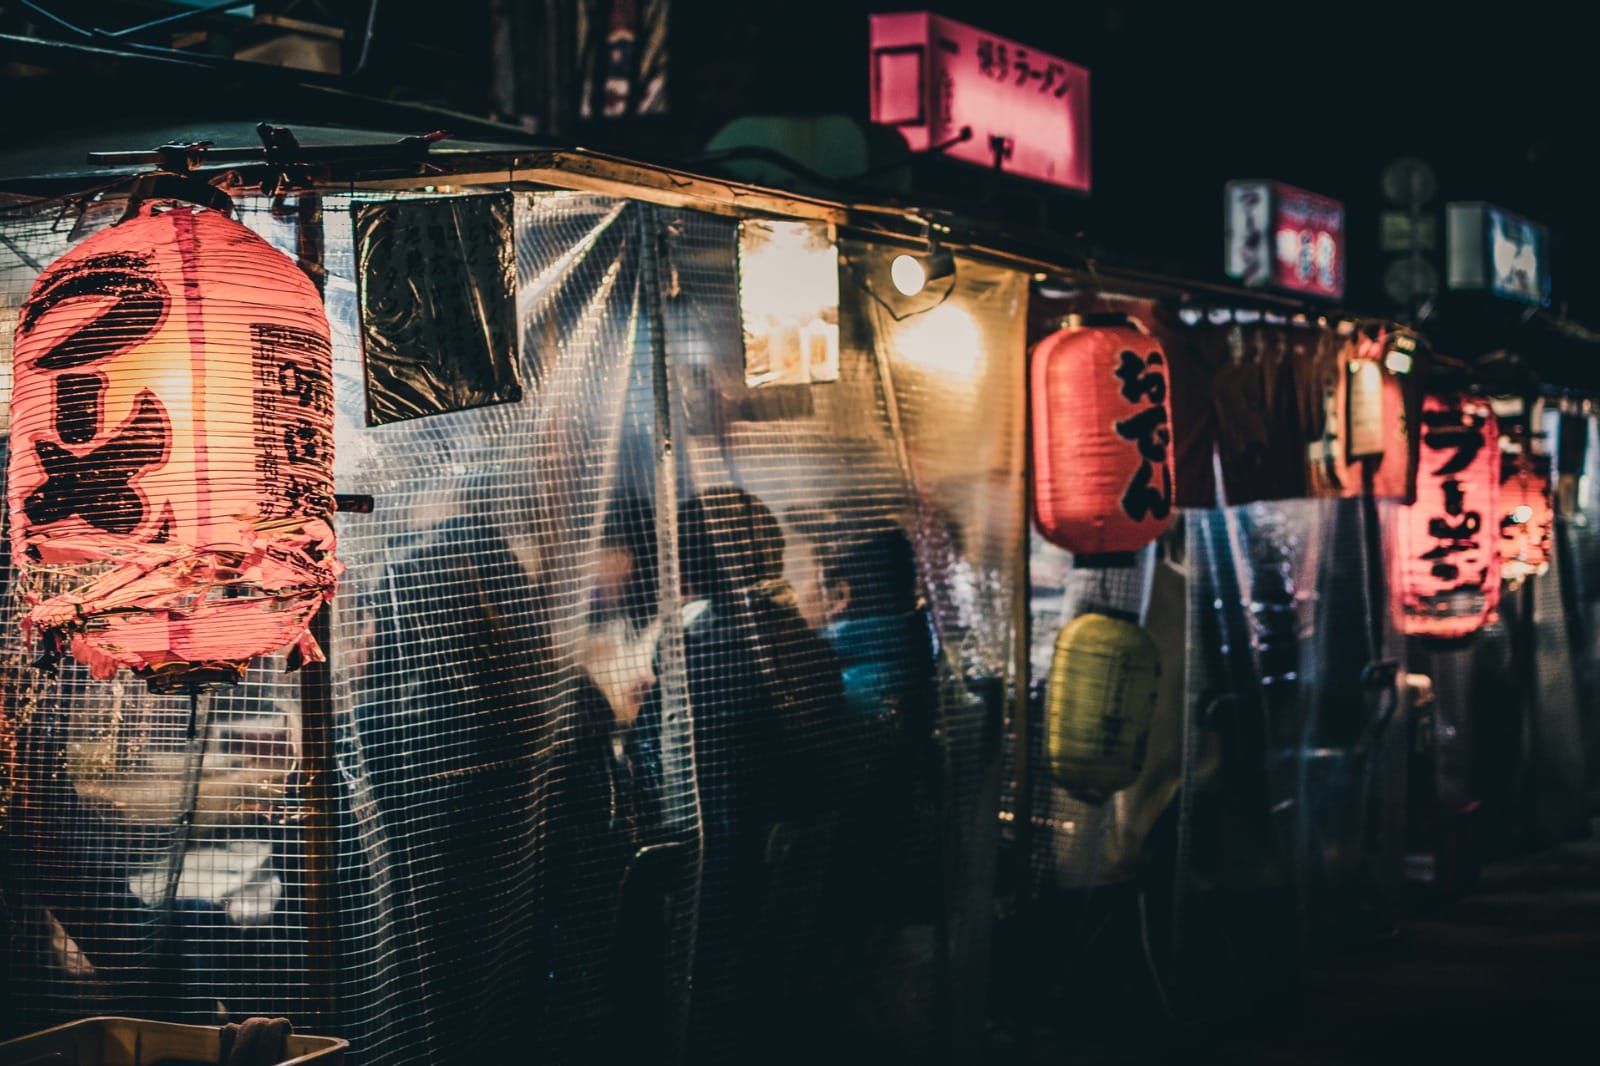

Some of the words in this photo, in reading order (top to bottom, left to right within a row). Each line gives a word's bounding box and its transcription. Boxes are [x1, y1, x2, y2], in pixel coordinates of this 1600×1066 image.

[22, 249, 172, 543] ラーメ
[1115, 350, 1171, 522] おでん
[1420, 409, 1487, 588] ラーメ
